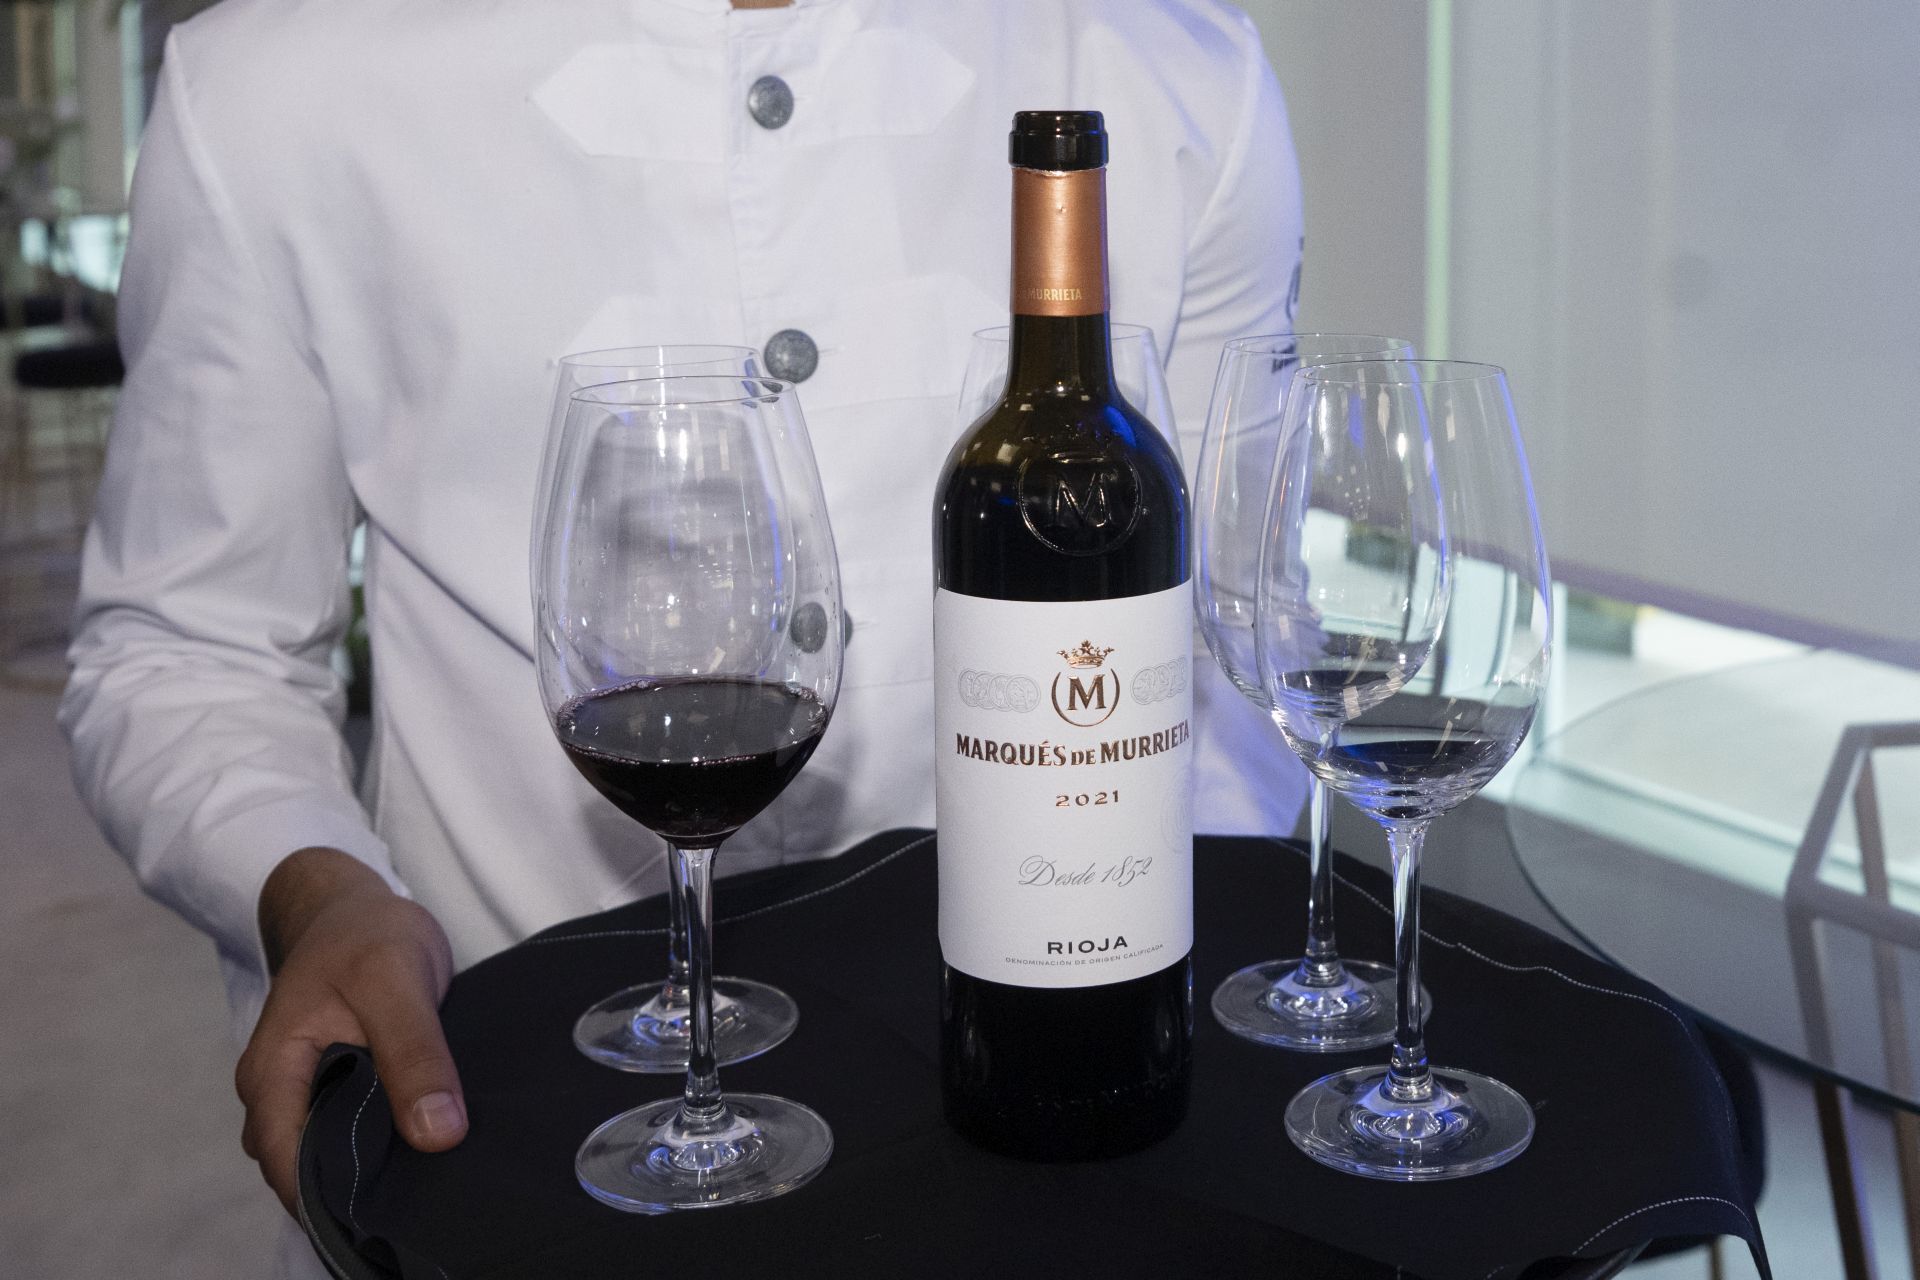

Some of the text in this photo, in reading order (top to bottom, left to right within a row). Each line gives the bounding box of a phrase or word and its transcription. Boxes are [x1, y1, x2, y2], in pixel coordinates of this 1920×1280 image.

[1067, 674, 1106, 711] M
[956, 720, 1189, 766] MARQUÉS DE MURRIETA
[1056, 790, 1119, 807] 2021
[1018, 855, 1153, 887] Desde 1852
[1005, 957, 1072, 966] DENOMINACIÓN
[1089, 955, 1121, 965] ORIGEN
[1123, 943, 1164, 959] CALIFICADA
[1047, 935, 1128, 955] RIOJA
